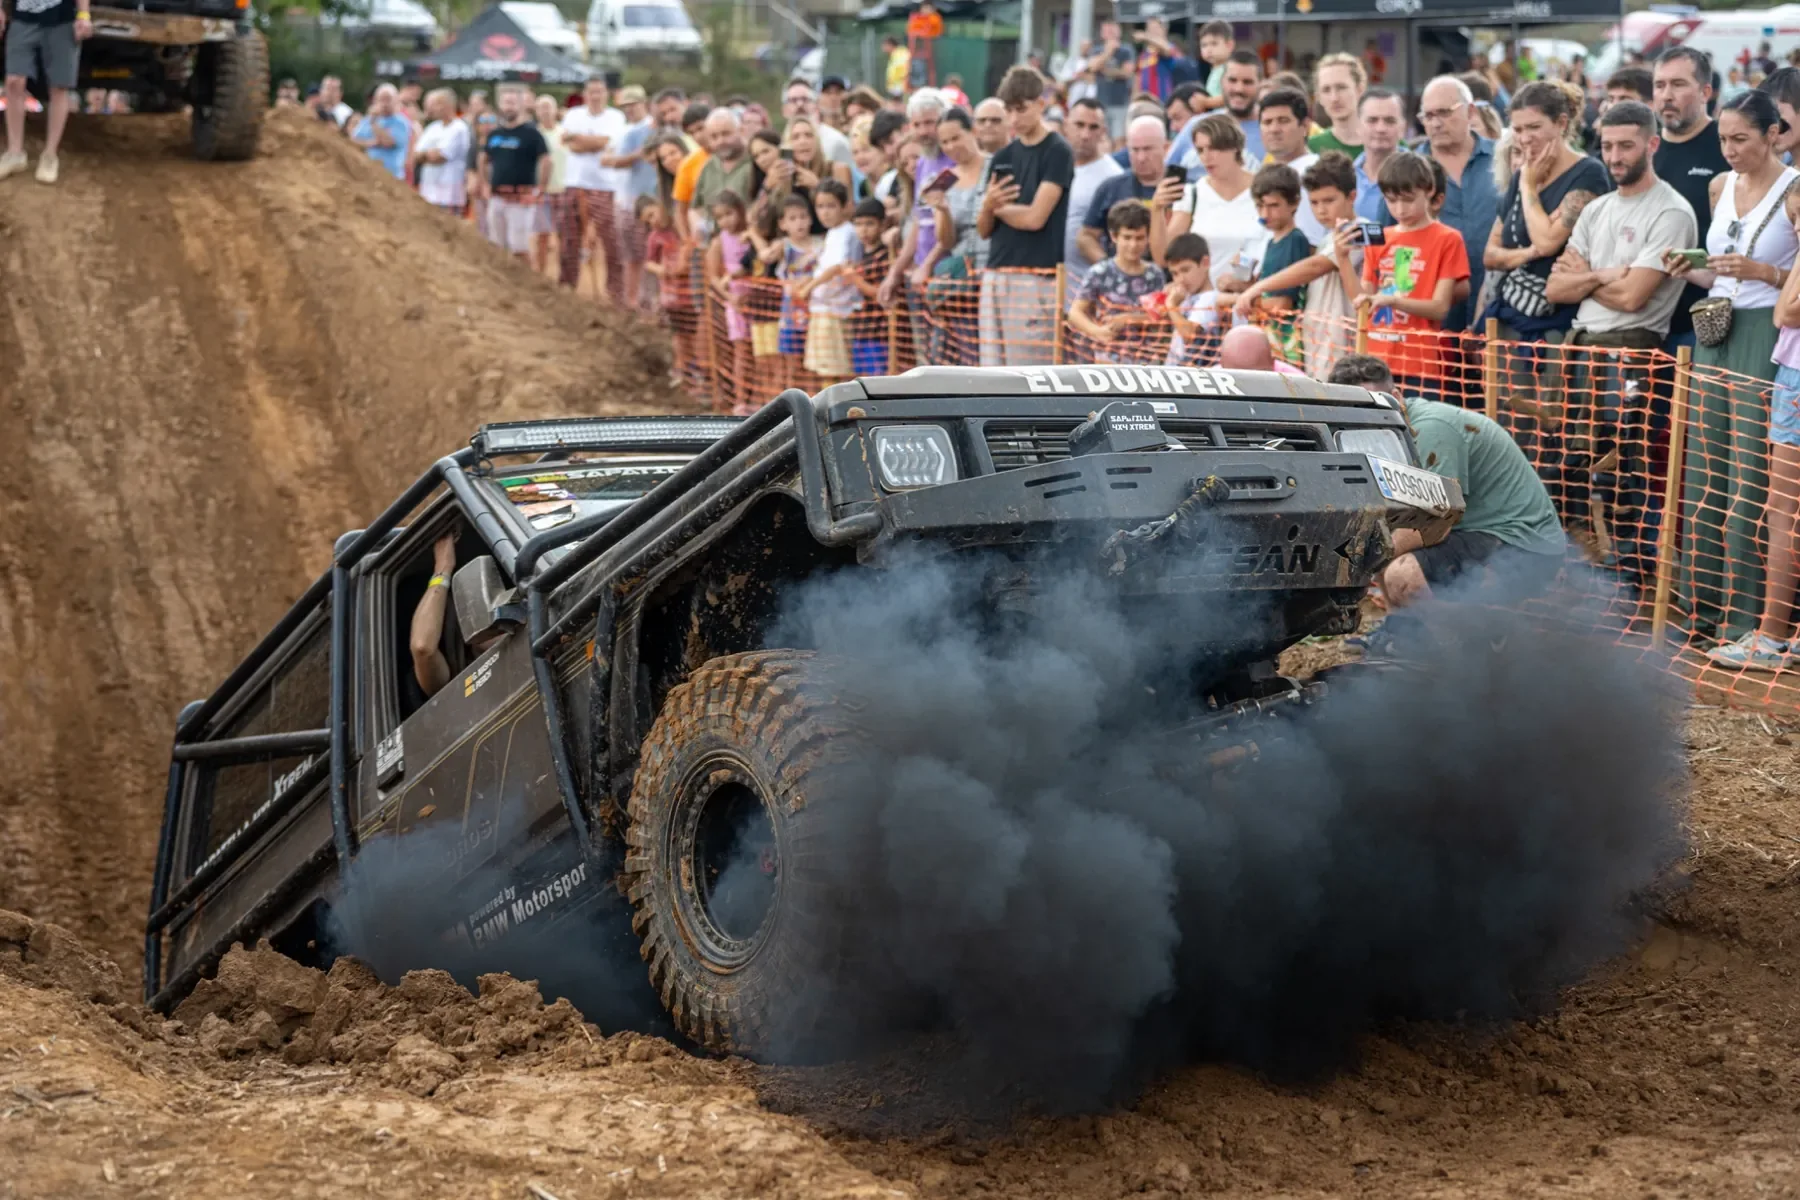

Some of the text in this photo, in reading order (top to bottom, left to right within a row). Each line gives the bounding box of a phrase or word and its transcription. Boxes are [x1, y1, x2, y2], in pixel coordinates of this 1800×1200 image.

[1024, 367, 1245, 396] EL DUMPER
[1112, 423, 1156, 431] 4X4 XTREM
[469, 885, 516, 929] powered by
[511, 862, 586, 925] Motorspor
